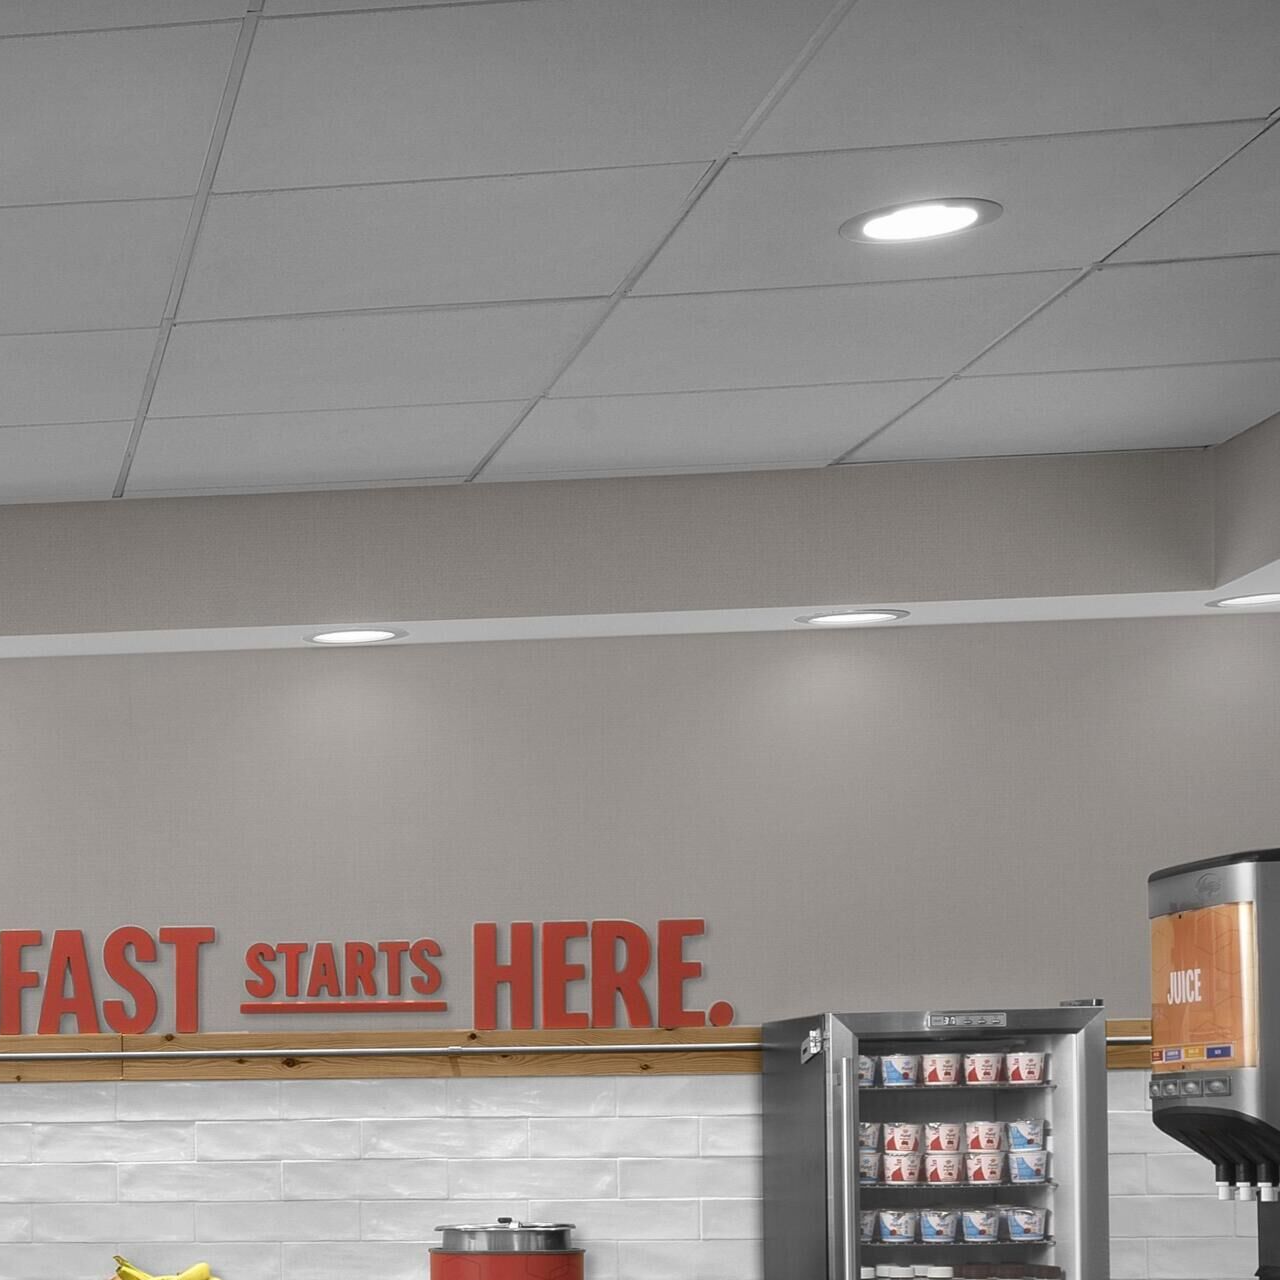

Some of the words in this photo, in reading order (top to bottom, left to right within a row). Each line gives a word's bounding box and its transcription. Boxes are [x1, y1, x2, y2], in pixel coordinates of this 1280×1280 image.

[244, 939, 442, 998] STARTS
[473, 919, 733, 1031] HERE.
[1167, 968, 1202, 1005] JUICE
